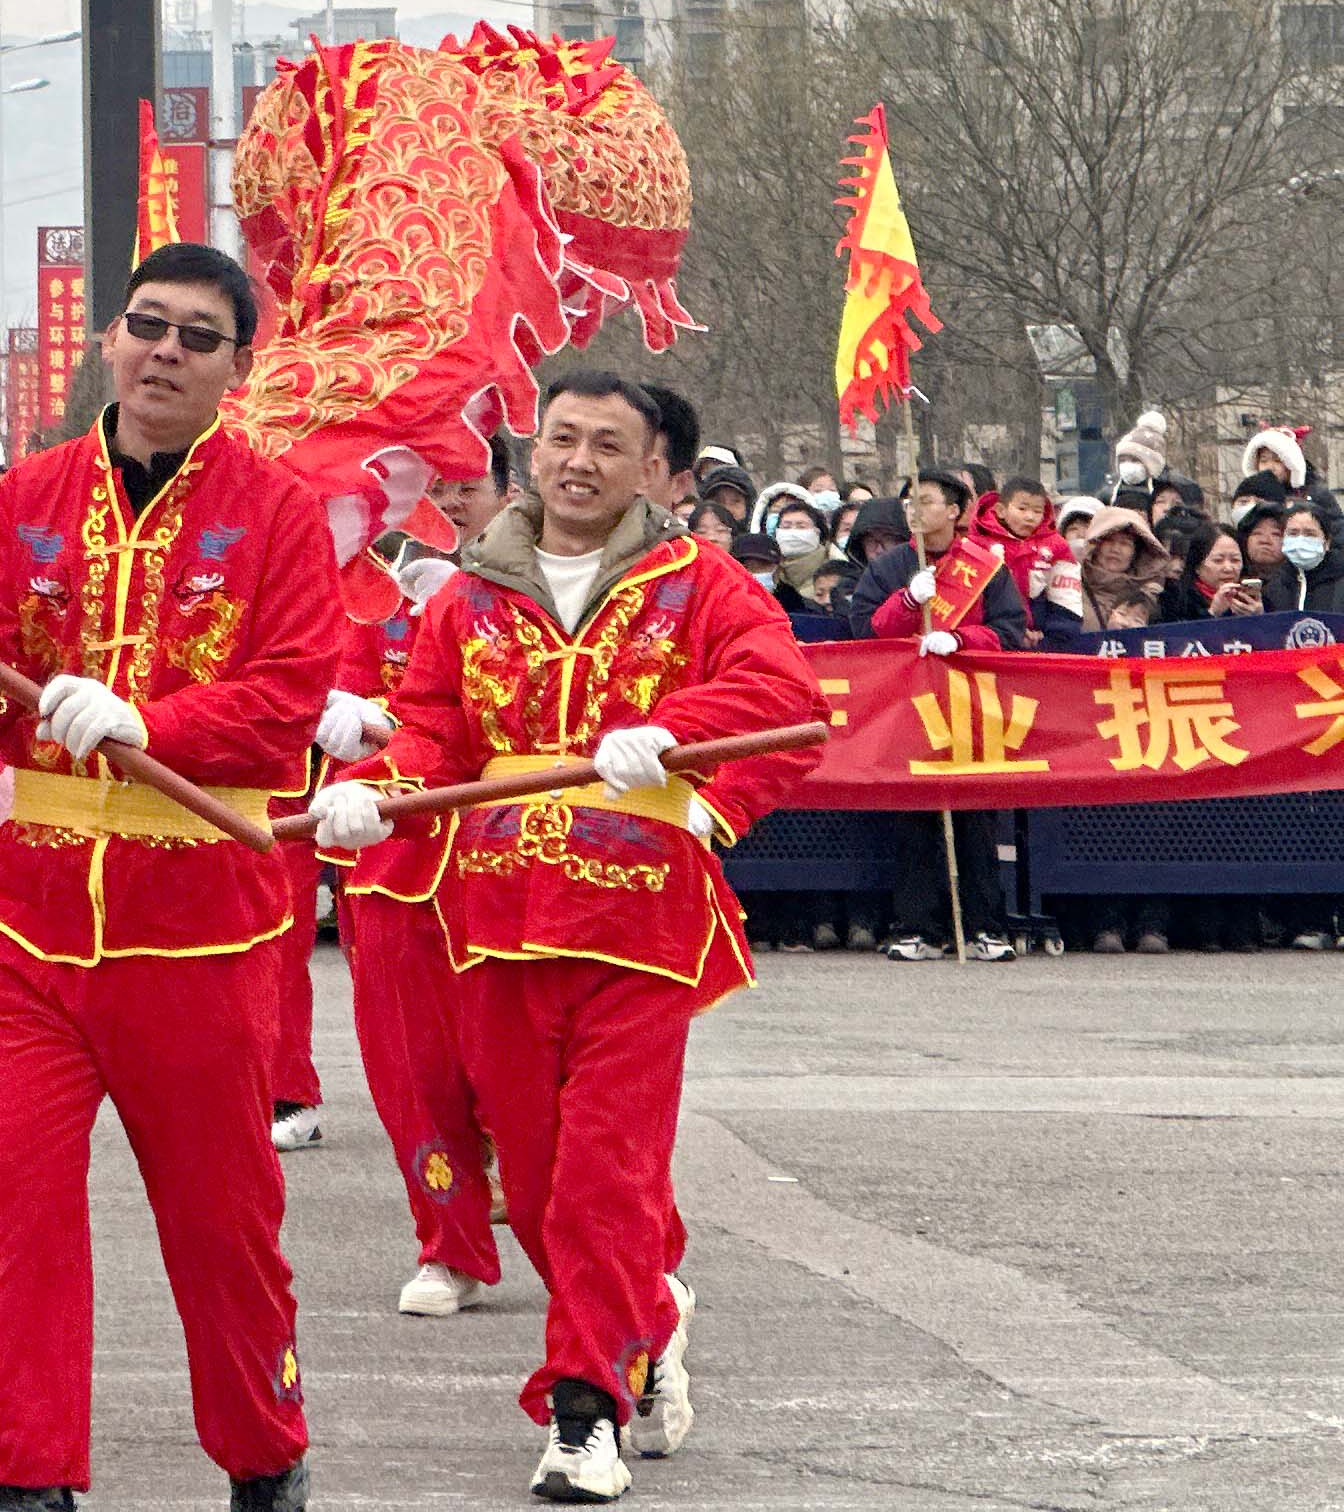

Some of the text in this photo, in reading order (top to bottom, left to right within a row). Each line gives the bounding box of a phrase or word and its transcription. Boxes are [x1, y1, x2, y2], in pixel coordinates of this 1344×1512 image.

[48, 278, 66, 416] 参与环境整治
[819, 659, 1344, 775] 业振
